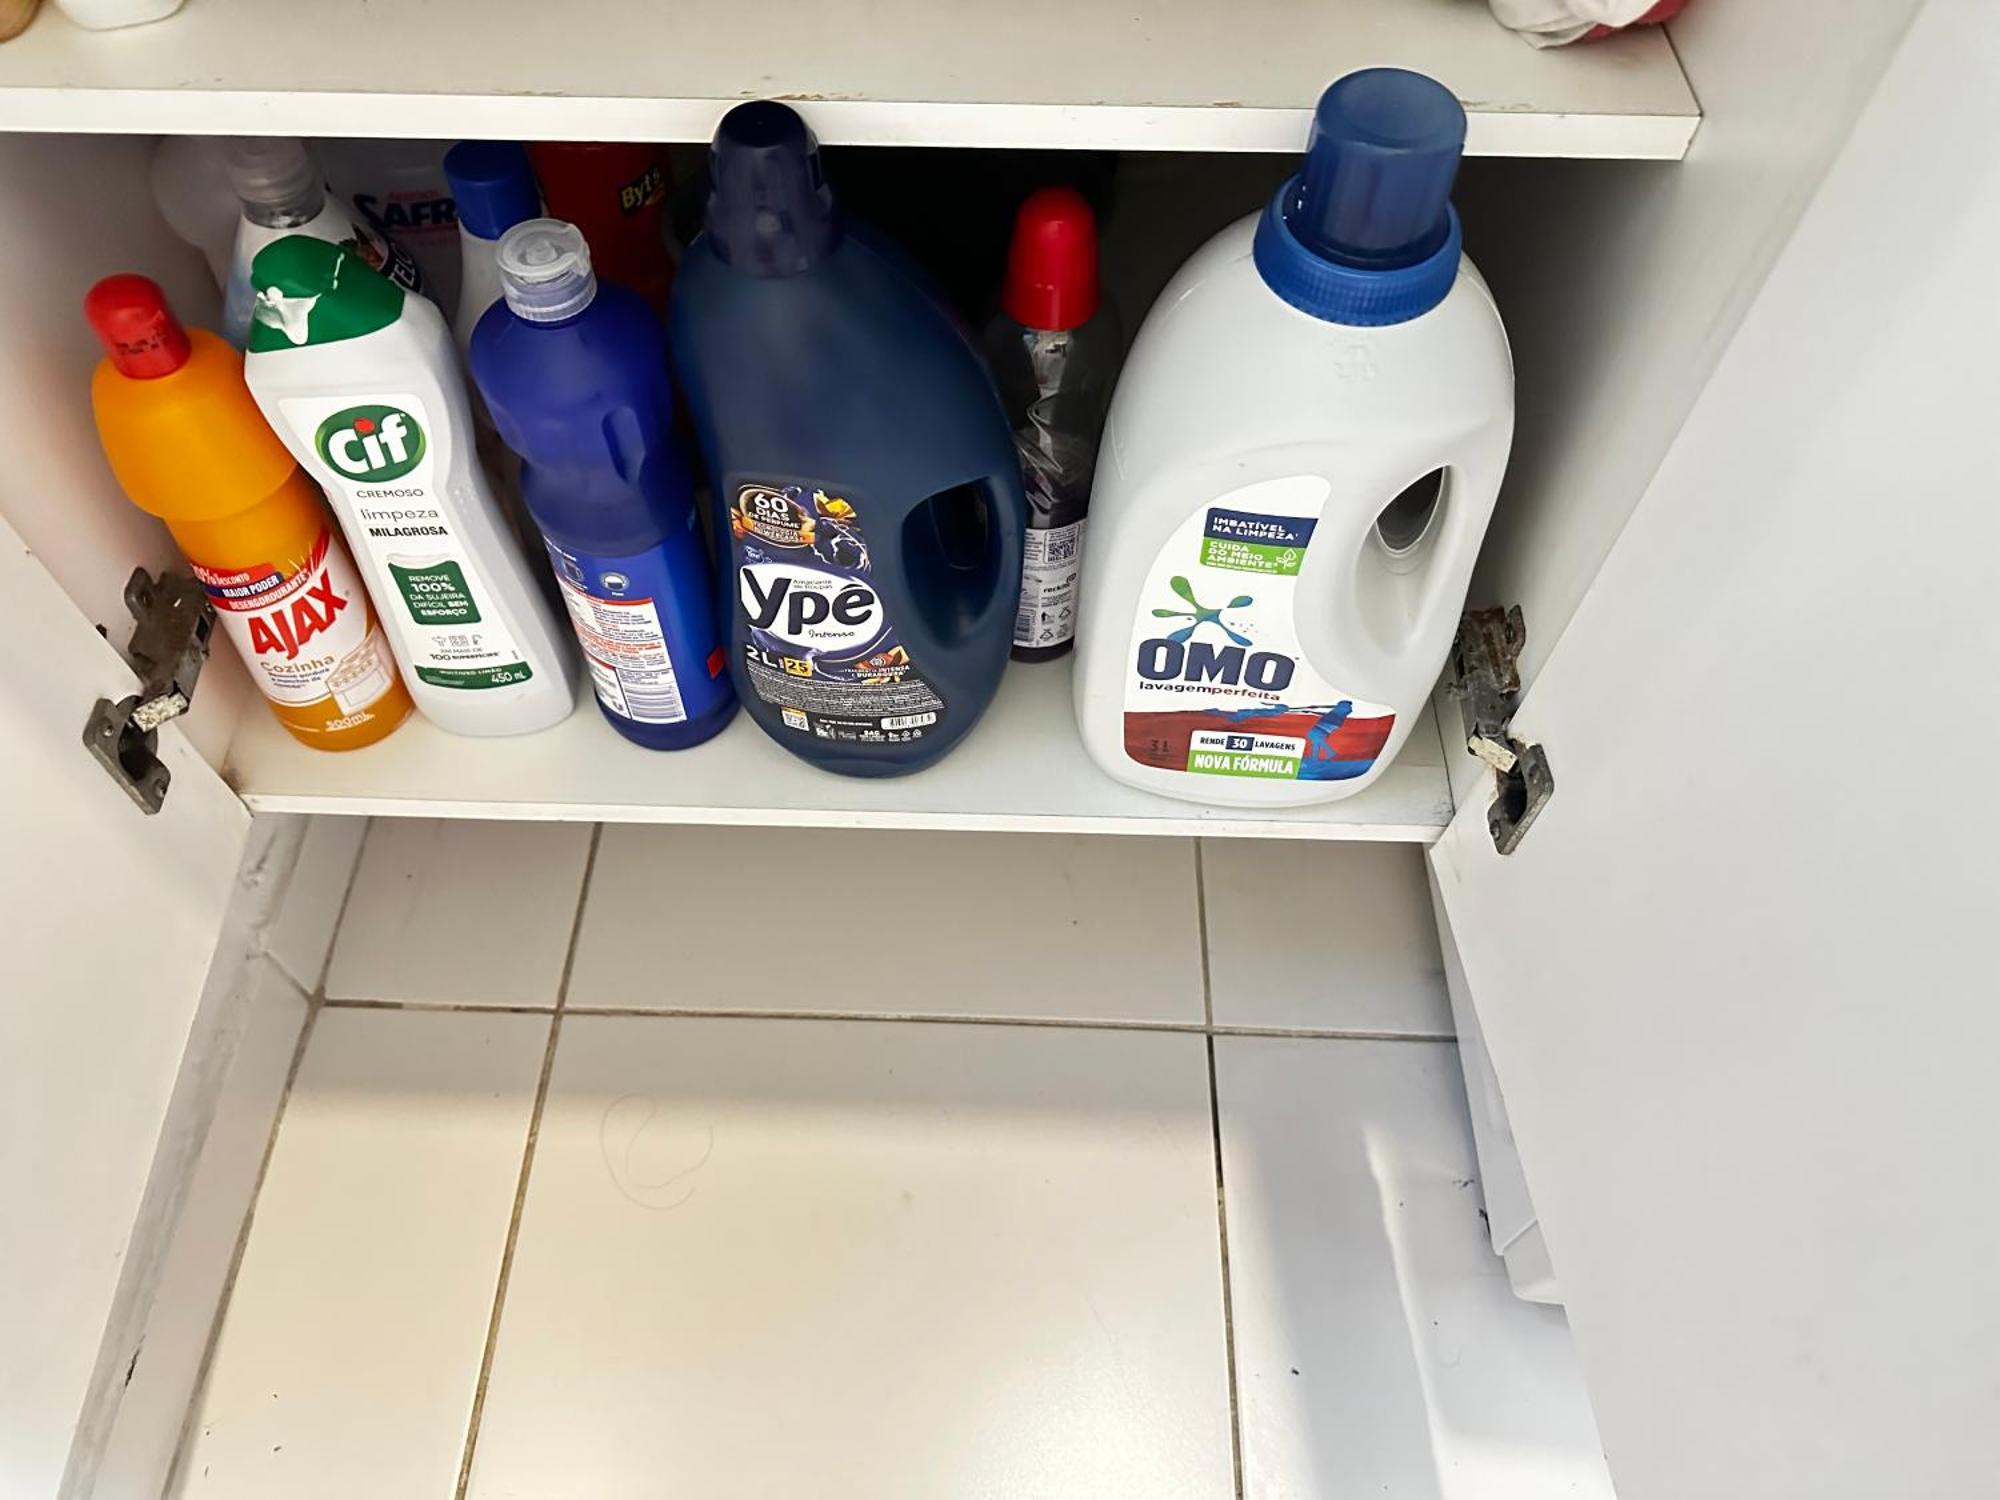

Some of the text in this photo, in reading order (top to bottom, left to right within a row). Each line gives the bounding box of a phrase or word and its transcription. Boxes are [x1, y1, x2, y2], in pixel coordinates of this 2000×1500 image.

[353, 193, 458, 231] SAFR
[328, 412, 408, 474] Cif
[356, 488, 424, 499] CREMOSO
[754, 493, 788, 512] 60
[360, 508, 438, 522] limpeza
[756, 506, 790, 522] DIAS
[369, 526, 449, 537] MILAGROSA
[1212, 524, 1231, 535] NA
[1213, 516, 1286, 533] IMBATÍVEL
[1209, 541, 1249, 552] CUIDA
[1208, 547, 1263, 562] DO MEIO
[249, 576, 280, 595] PODER
[408, 574, 451, 582] REMOVE
[410, 582, 456, 592] 100%
[743, 568, 875, 635] Ypê
[247, 568, 347, 660] AJAX
[421, 609, 467, 617] ESFORÇO
[259, 654, 336, 673] Cozinha
[787, 659, 808, 673] 25
[1136, 638, 1296, 692] OMO
[492, 672, 513, 683] 450
[1200, 736, 1296, 751] RENDE 30 LAVAGENS
[1194, 754, 1294, 774] NOVA FÓRMULA
